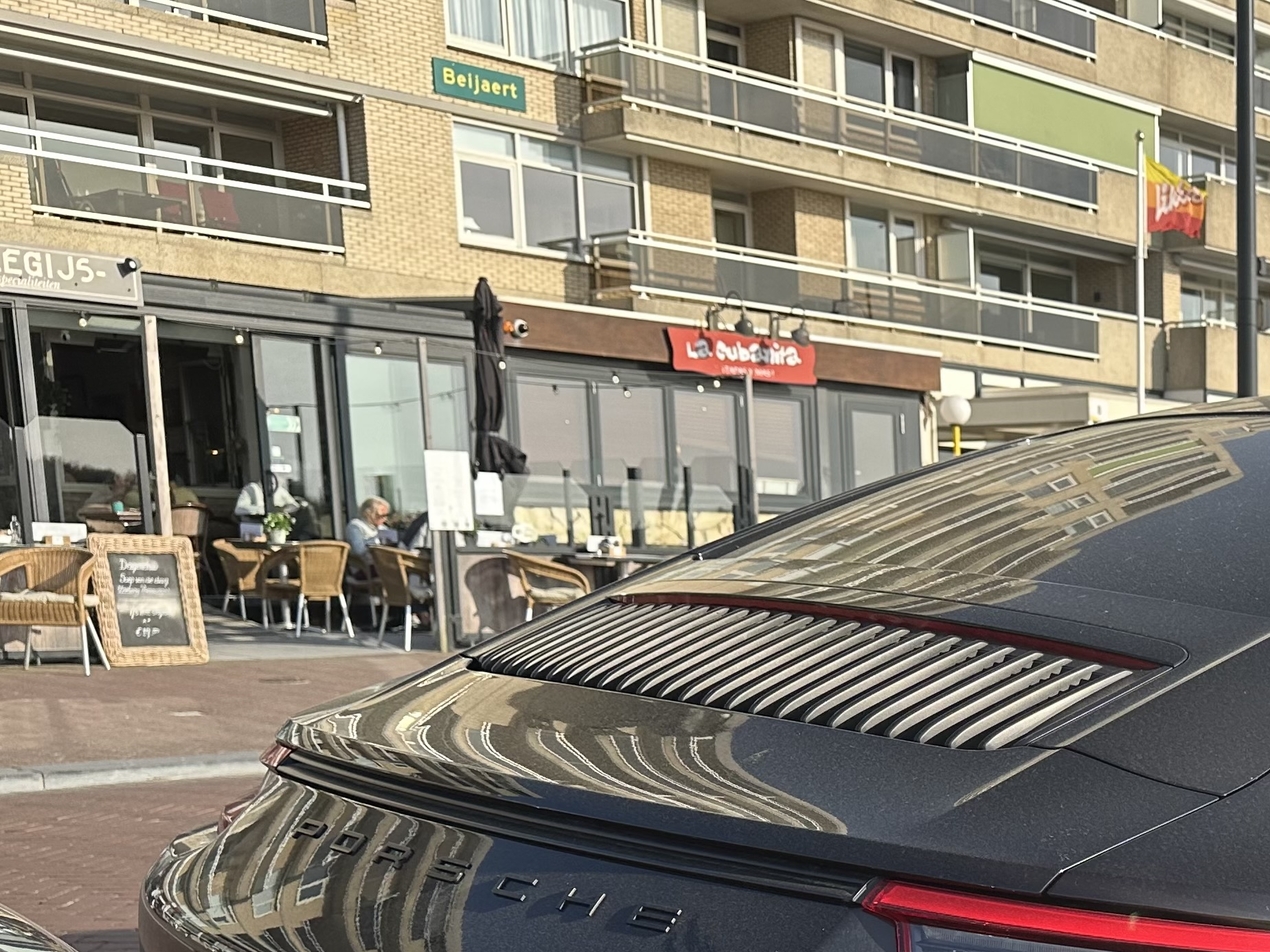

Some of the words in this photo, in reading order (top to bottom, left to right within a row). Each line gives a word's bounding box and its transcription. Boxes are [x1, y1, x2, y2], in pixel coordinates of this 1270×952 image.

[442, 66, 518, 99] Beijaert
[0, 247, 107, 283] EGIJS-
[0, 274, 61, 291] pecialiteiten
[292, 818, 682, 934] PORSCHE
